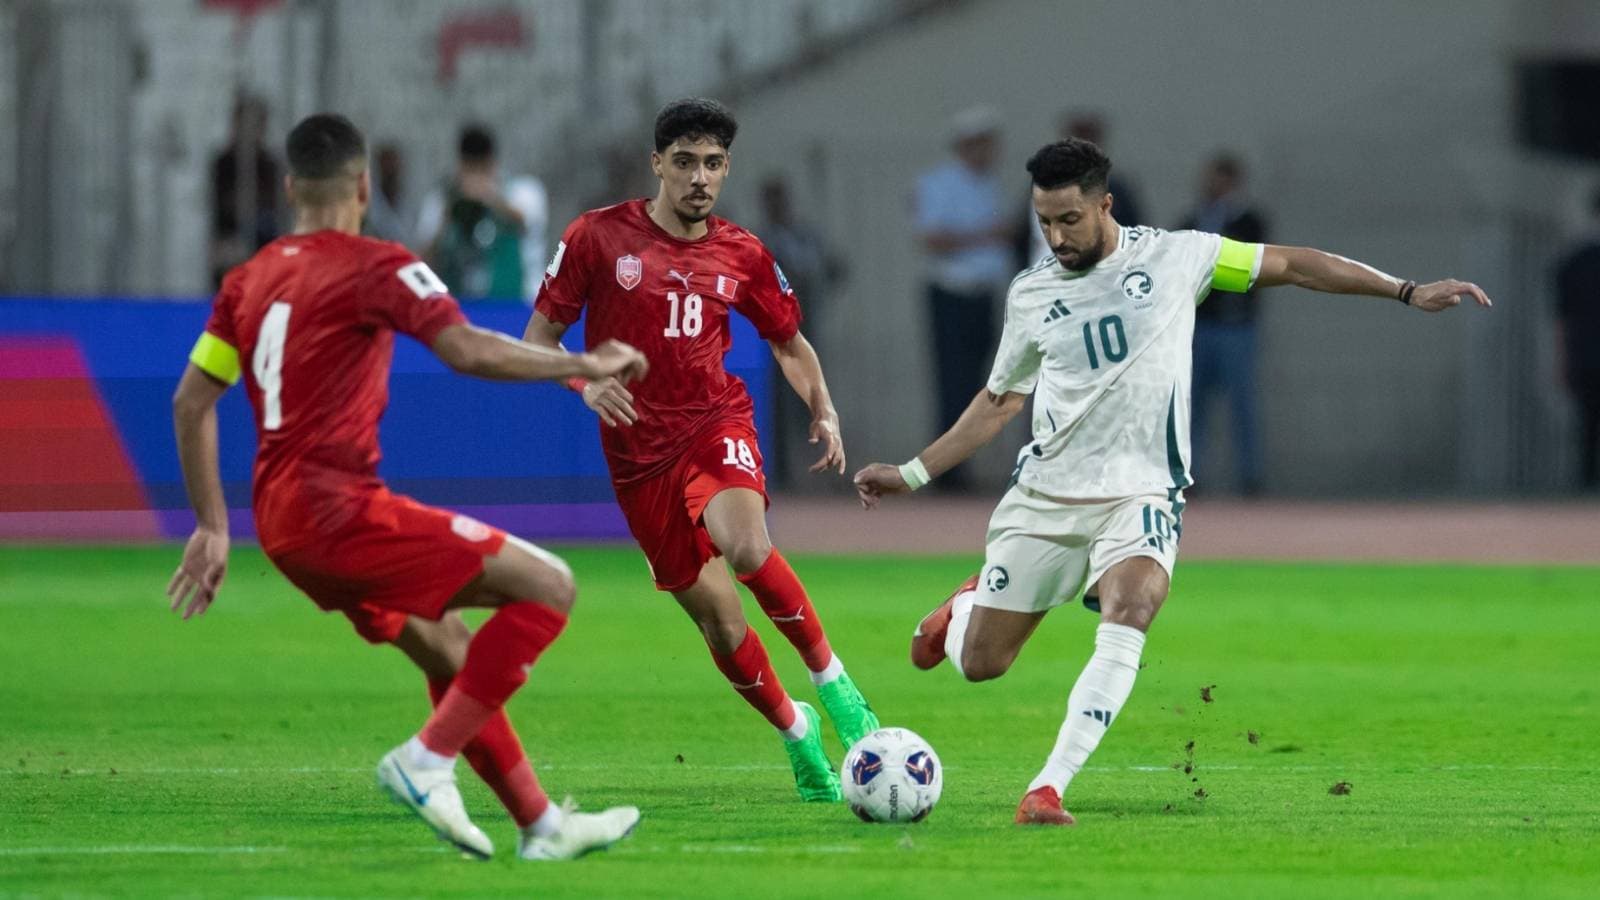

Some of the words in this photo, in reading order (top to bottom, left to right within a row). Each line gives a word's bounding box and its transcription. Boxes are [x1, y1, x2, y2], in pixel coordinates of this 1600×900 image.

[663, 291, 703, 338] 18
[1082, 314, 1129, 370] 10
[252, 301, 292, 432] 4
[722, 437, 756, 469] 18
[1142, 503, 1172, 541] 10
